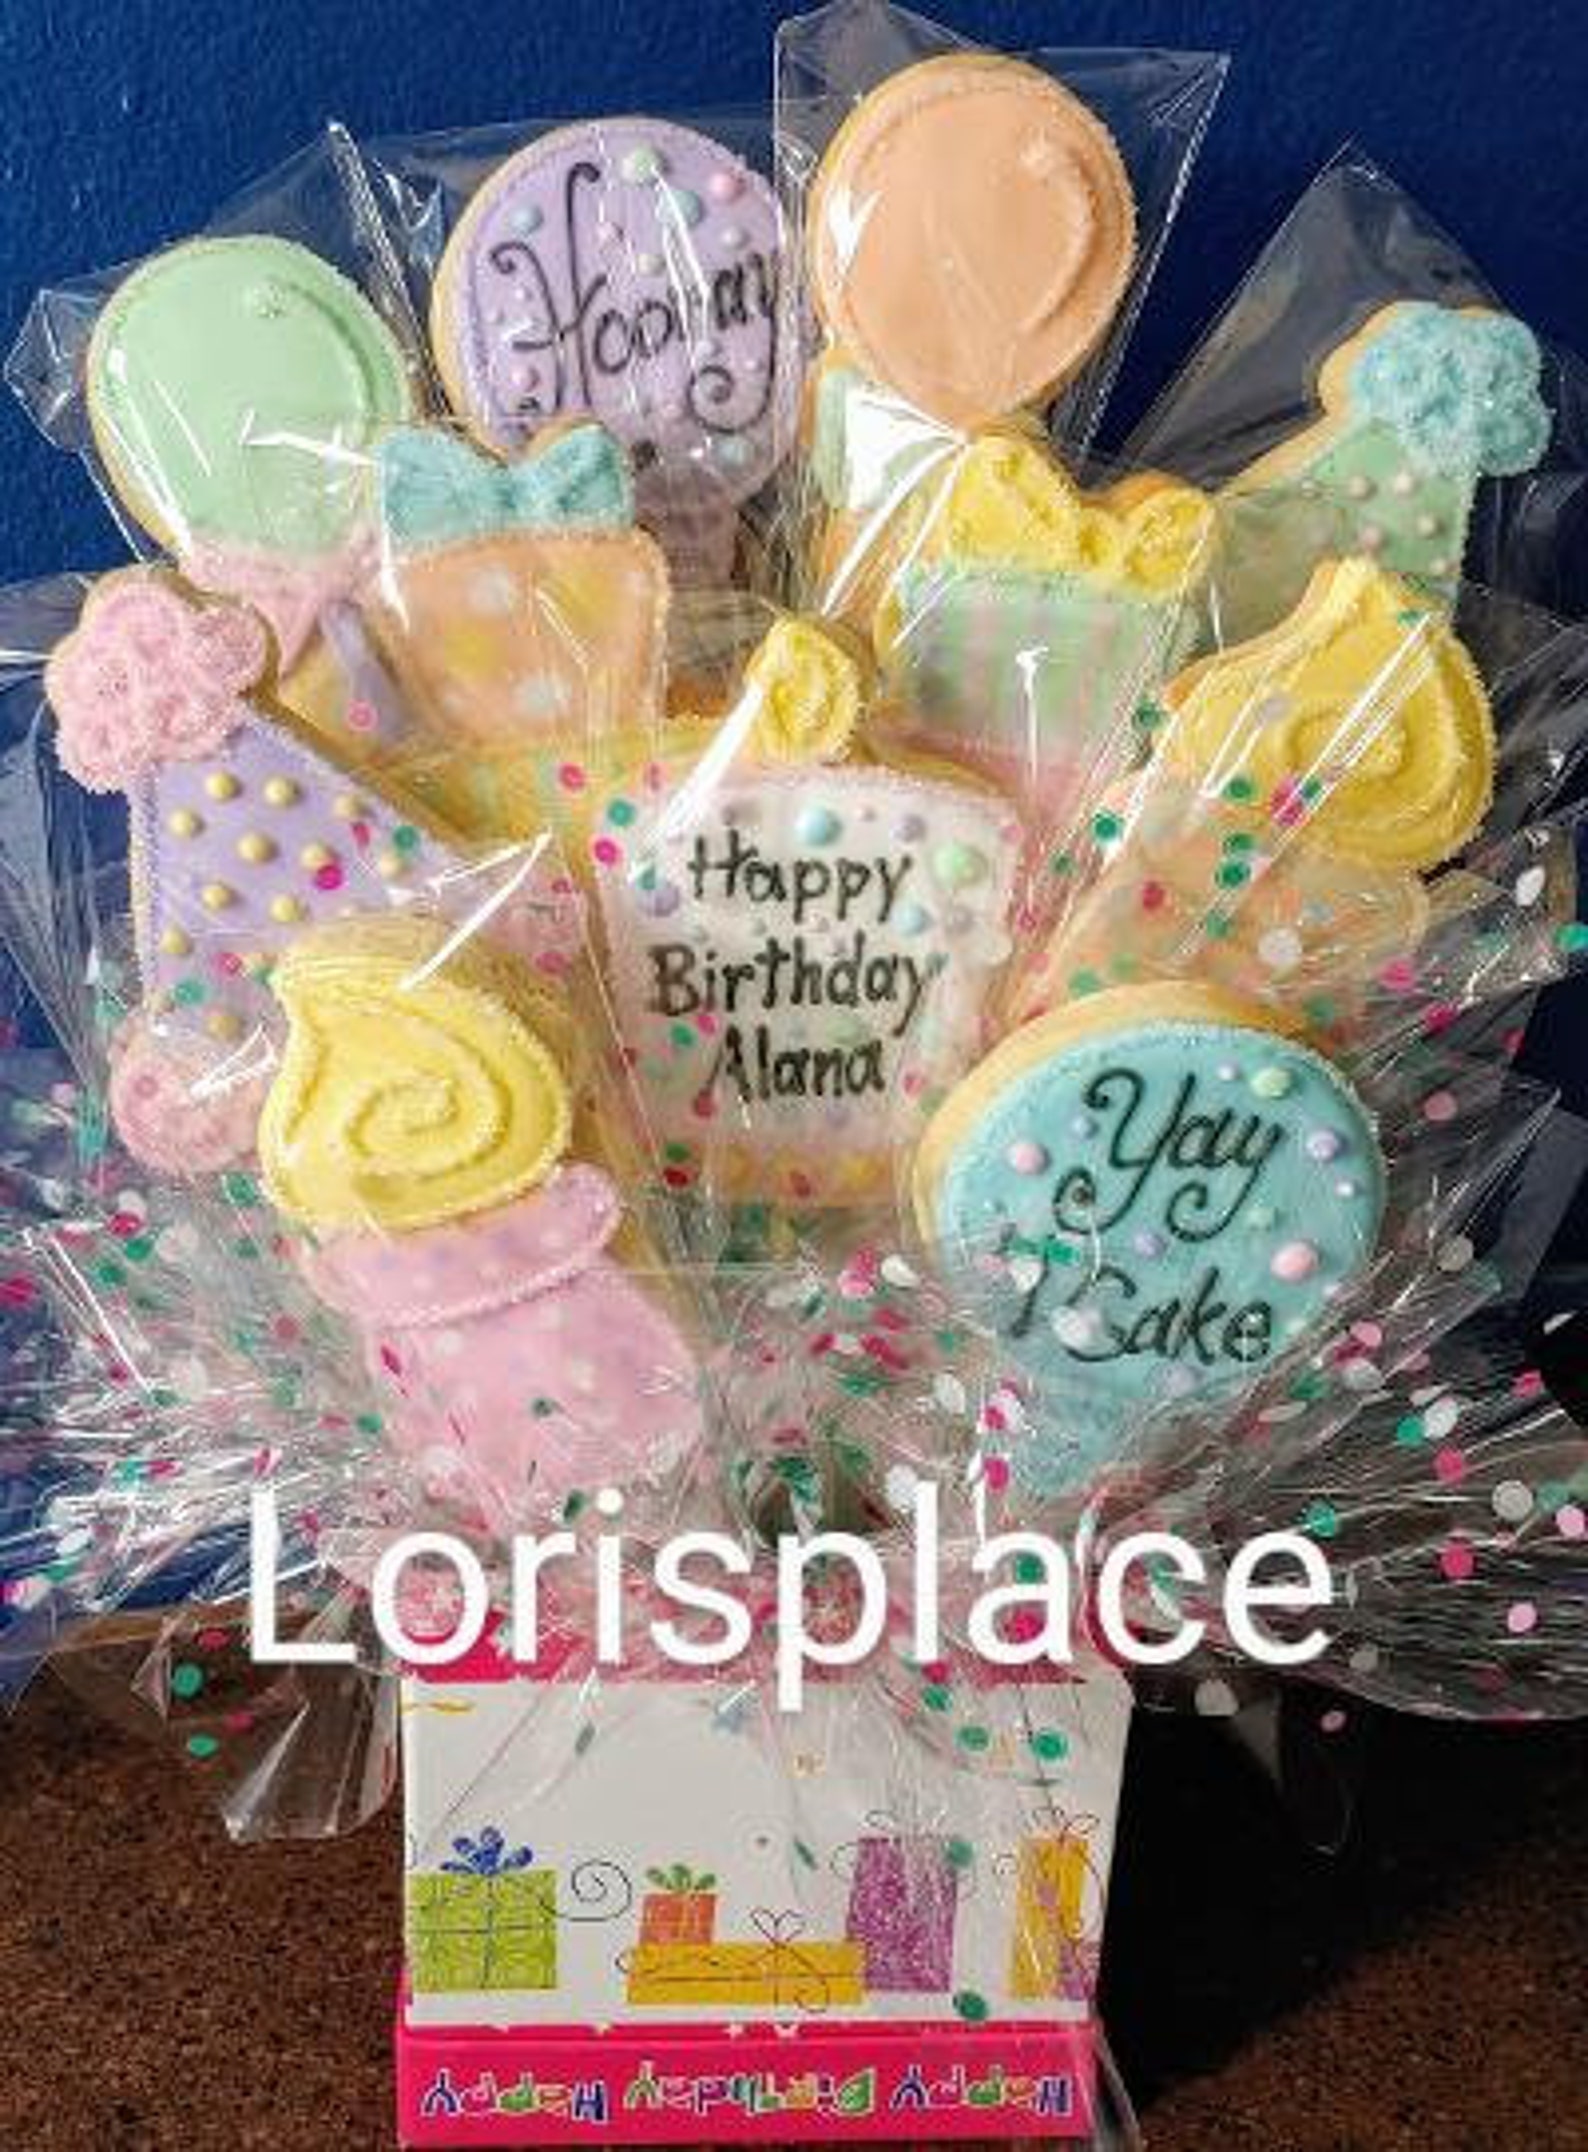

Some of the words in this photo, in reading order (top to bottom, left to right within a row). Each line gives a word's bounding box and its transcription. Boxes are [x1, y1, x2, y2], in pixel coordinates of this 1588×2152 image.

[687, 828, 913, 923] Happy
[648, 929, 934, 1038] Birthday
[702, 1023, 886, 1103] Alana
[1052, 1067, 1285, 1243] Yay
[1059, 1265, 1273, 1365] Cake
[420, 2067, 608, 2122] Happy
[891, 2063, 1072, 2118] Happy
